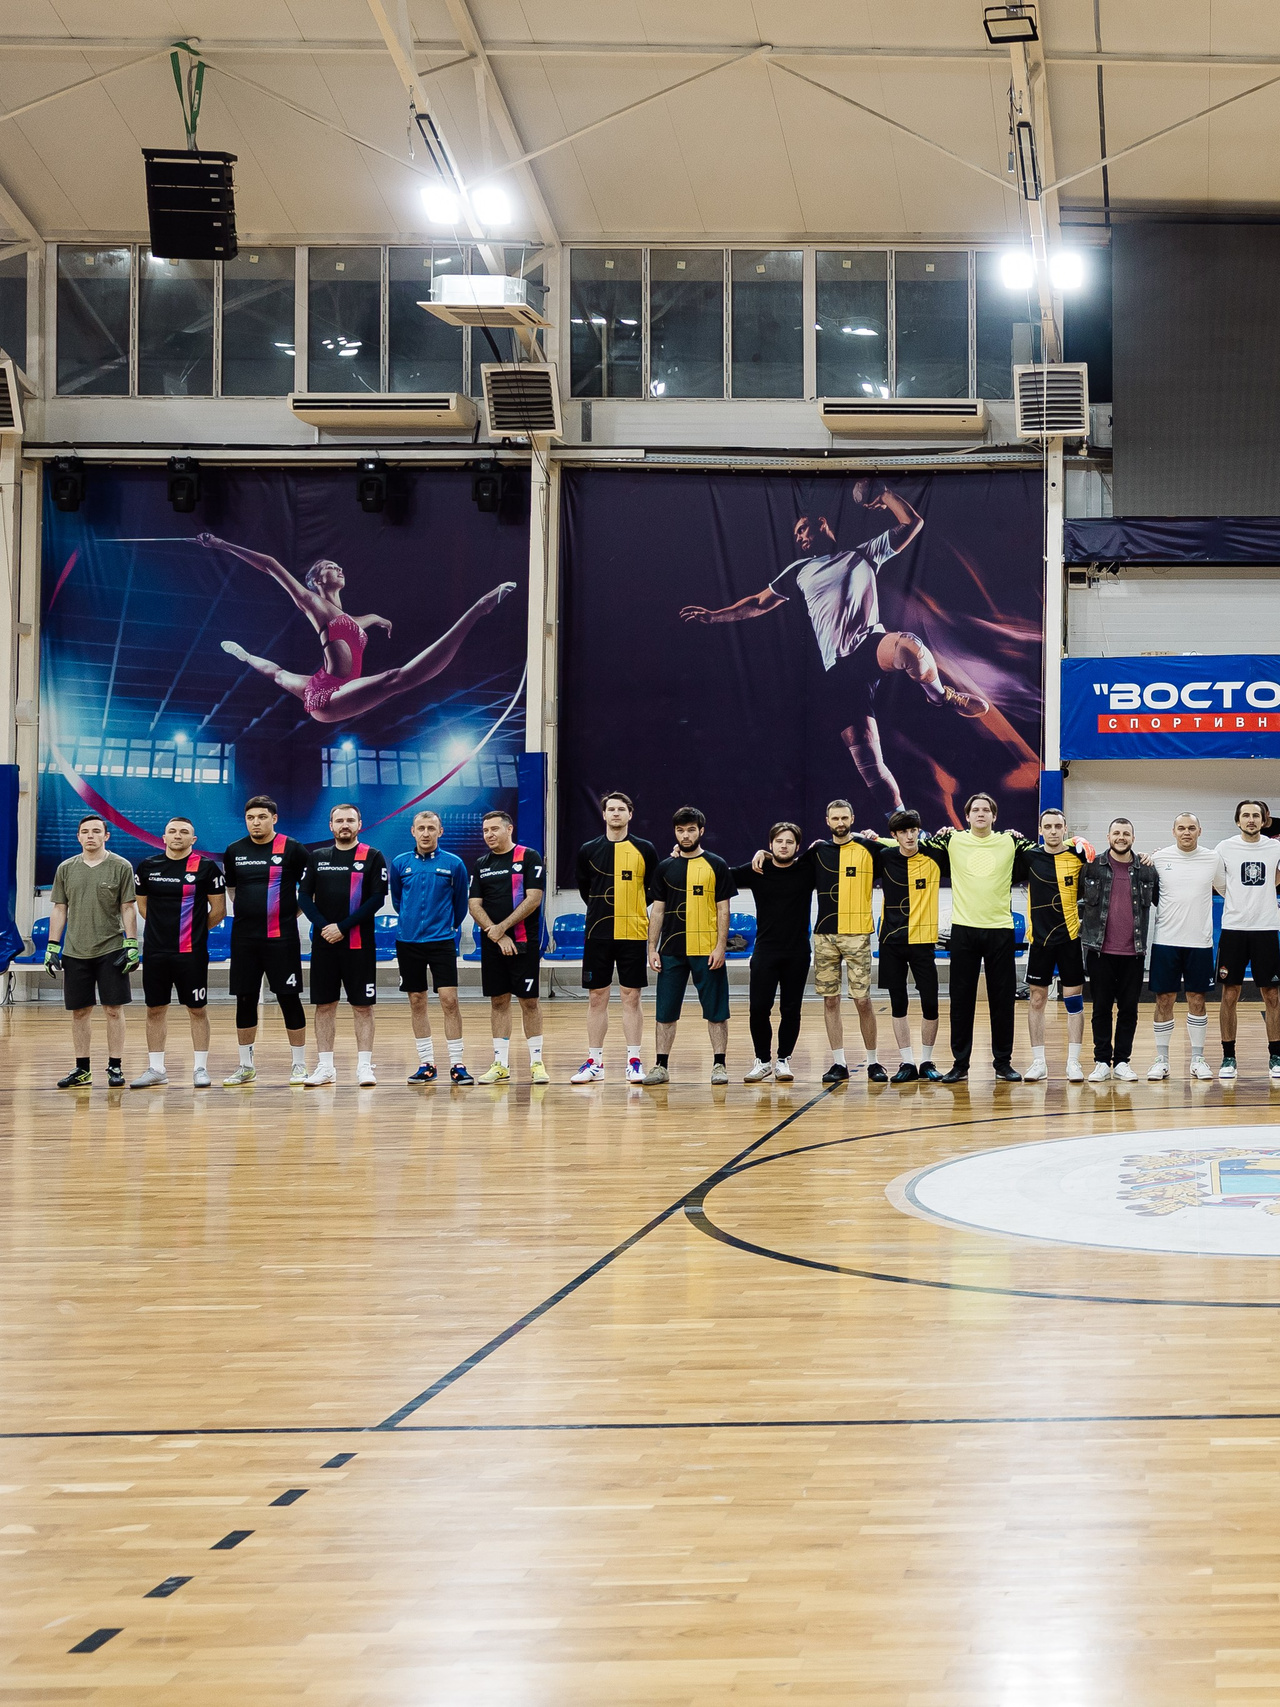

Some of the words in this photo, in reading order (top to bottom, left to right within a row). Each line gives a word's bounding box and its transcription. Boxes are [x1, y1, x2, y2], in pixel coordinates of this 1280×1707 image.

[381, 867, 388, 881] 5
[534, 865, 543, 878] 7
[286, 973, 297, 987] 4
[525, 978, 534, 992] 7
[192, 987, 206, 1001] 10
[365, 983, 375, 998] 5
